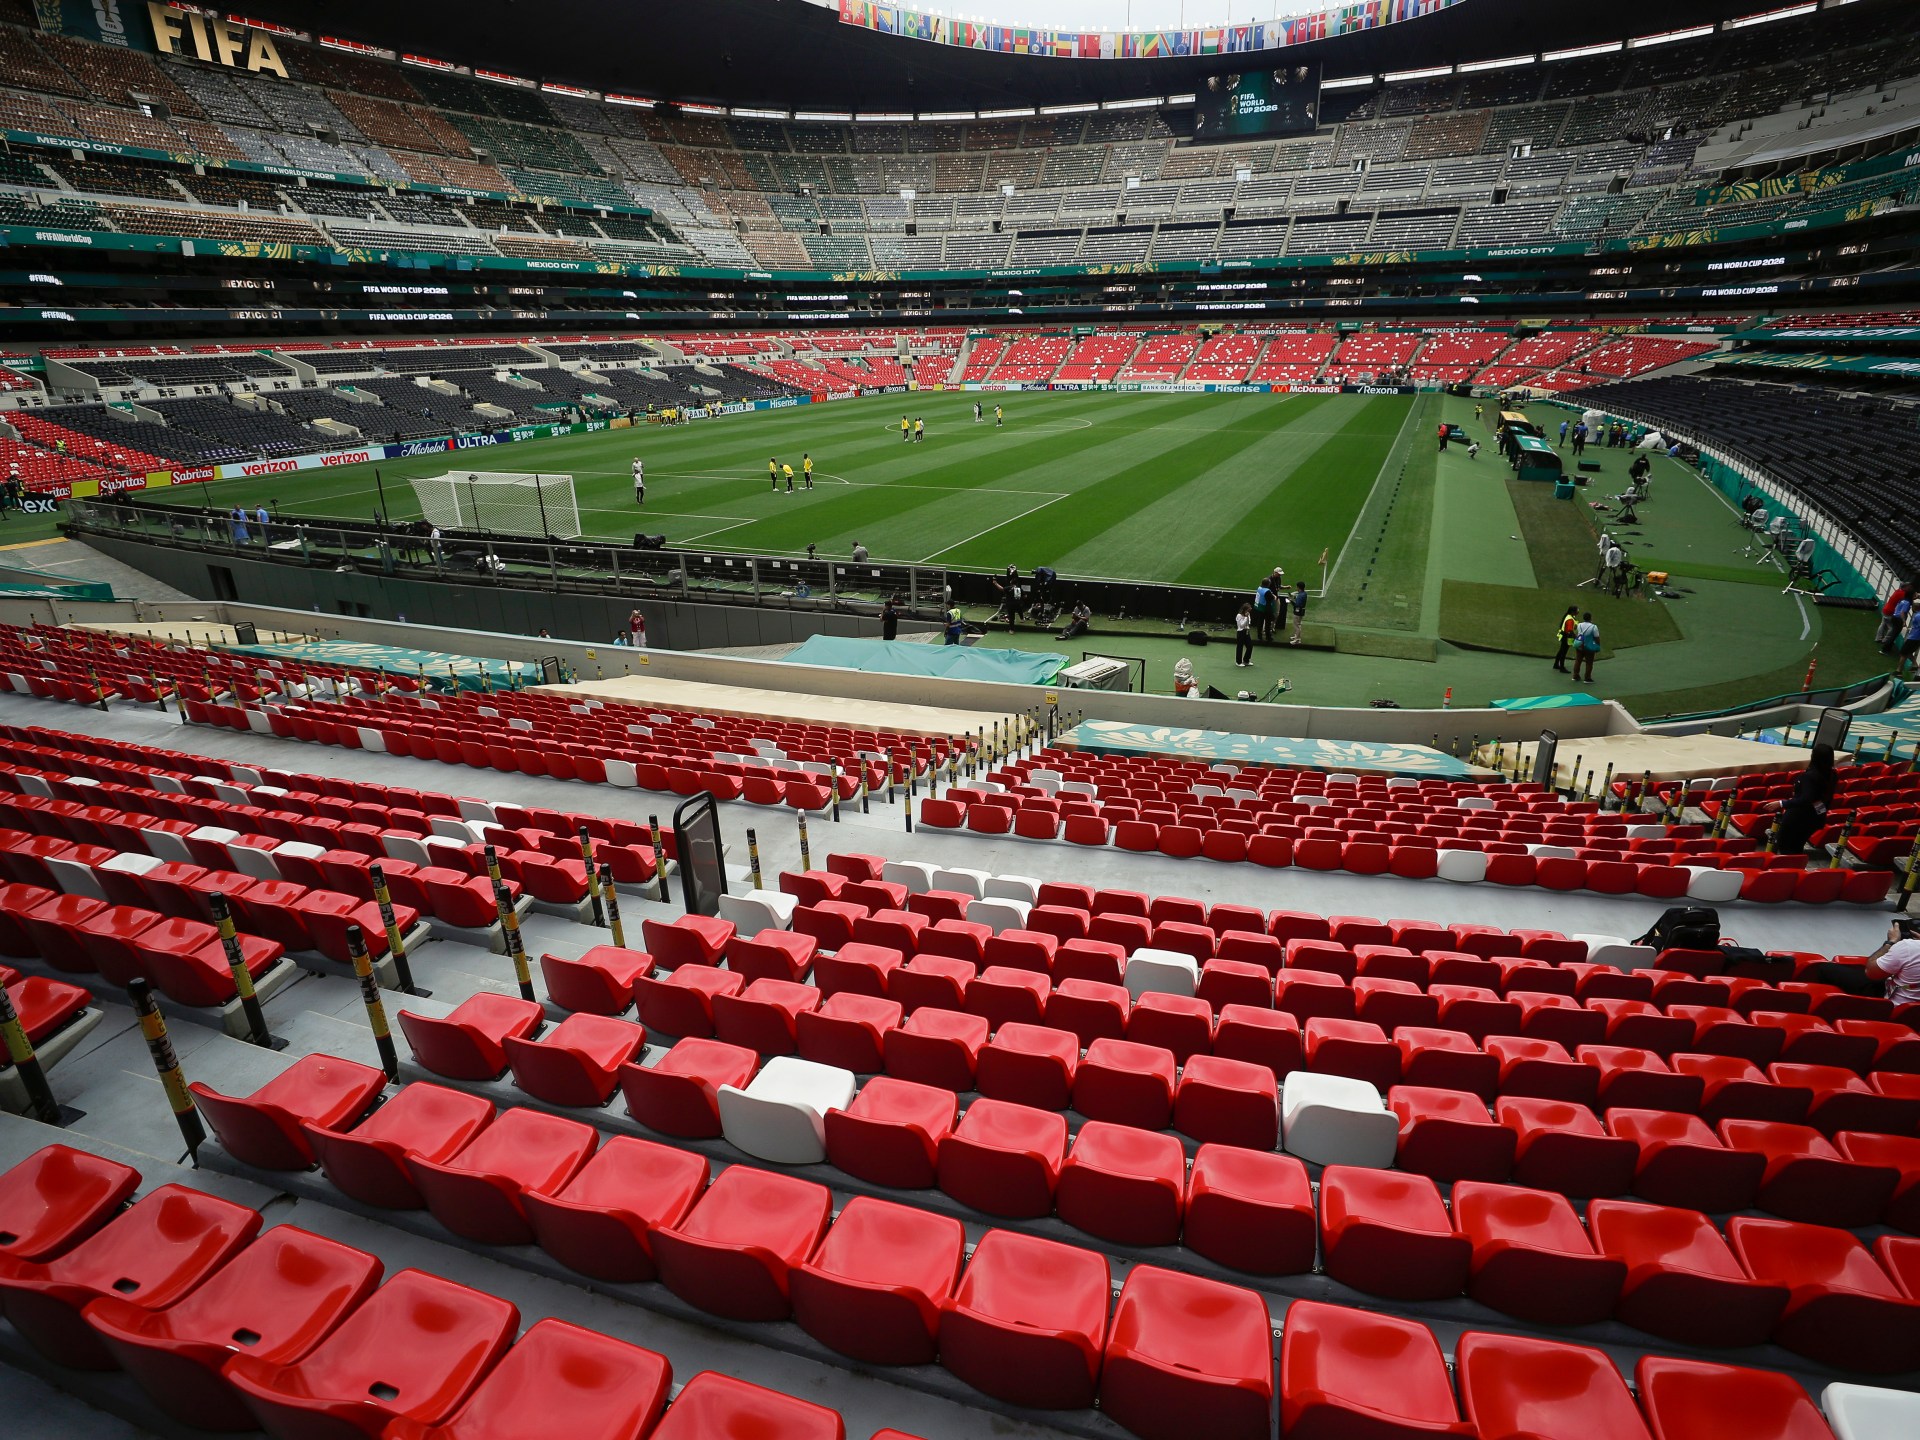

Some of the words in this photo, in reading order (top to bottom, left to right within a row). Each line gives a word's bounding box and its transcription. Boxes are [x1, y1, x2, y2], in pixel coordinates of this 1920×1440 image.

[101, 35, 129, 47] 2026
[147, 1, 290, 79] FIFA
[1239, 99, 1265, 107] WORLD
[1240, 93, 1255, 101] FIFA
[1253, 104, 1278, 113] 2026
[36, 135, 91, 149] MEXICO
[92, 143, 123, 154] CITY
[278, 167, 301, 176] WORLD
[301, 170, 314, 178] CUP
[314, 172, 336, 180] 2026
[440, 186, 471, 196] MEXICO
[472, 190, 490, 198] CITY
[35, 231, 93, 245] #FIFAWorldCup
[1488, 248, 1529, 256] MEXICO
[526, 261, 559, 269] MEXICO
[560, 262, 580, 270] CITY
[1708, 263, 1723, 271] FIFA
[1723, 261, 1749, 269] WORLD
[1762, 257, 1785, 266] 2026
[363, 285, 380, 293] FIFA
[408, 286, 423, 294] CUP
[1702, 289, 1717, 297] FIFA
[1717, 288, 1742, 296] WORLD
[1755, 285, 1778, 293] 2026
[886, 385, 906, 393] Rexona
[1215, 384, 1260, 393] Hisense
[1289, 385, 1340, 393] McDonald's
[1363, 386, 1399, 395] Rexona
[827, 390, 855, 401] McDonald's
[770, 398, 798, 409] Hisense
[400, 441, 446, 457] Michelob
[457, 434, 498, 449] ULTRA
[320, 451, 370, 466] verizon
[241, 460, 299, 476] verizon
[172, 468, 213, 484] Sabritas
[649, 822, 657, 831] 17
[747, 836, 755, 845] 17
[652, 841, 663, 858] 143
[583, 856, 594, 874] 143
[750, 855, 760, 873] 144
[371, 874, 382, 889] 20
[499, 899, 509, 914] 20
[604, 900, 618, 920] 144
[379, 902, 395, 927] 143
[506, 930, 520, 953] 144
